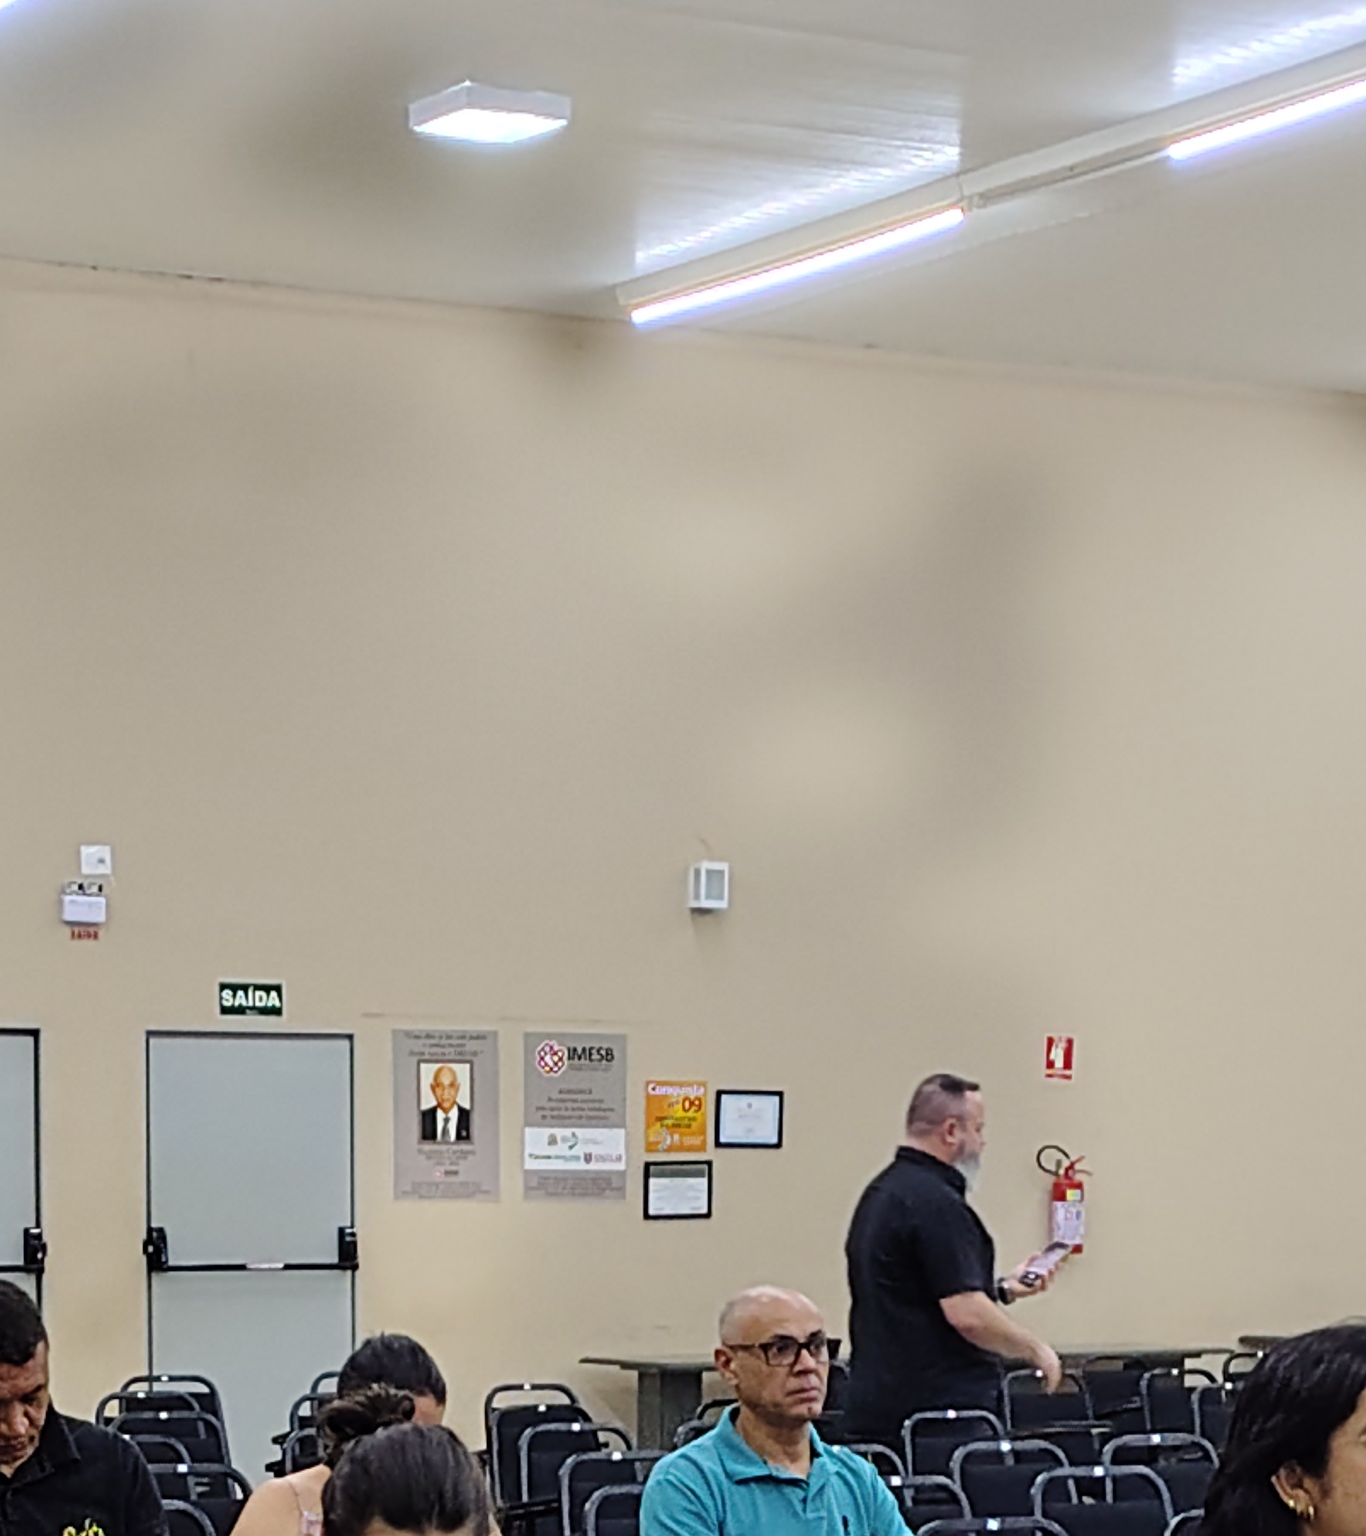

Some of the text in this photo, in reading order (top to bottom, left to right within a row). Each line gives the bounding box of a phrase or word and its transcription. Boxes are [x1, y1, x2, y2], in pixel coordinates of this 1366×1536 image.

[220, 985, 282, 1009] SAÍDA
[567, 1046, 615, 1063] IMESB
[681, 1096, 702, 1113] 09
